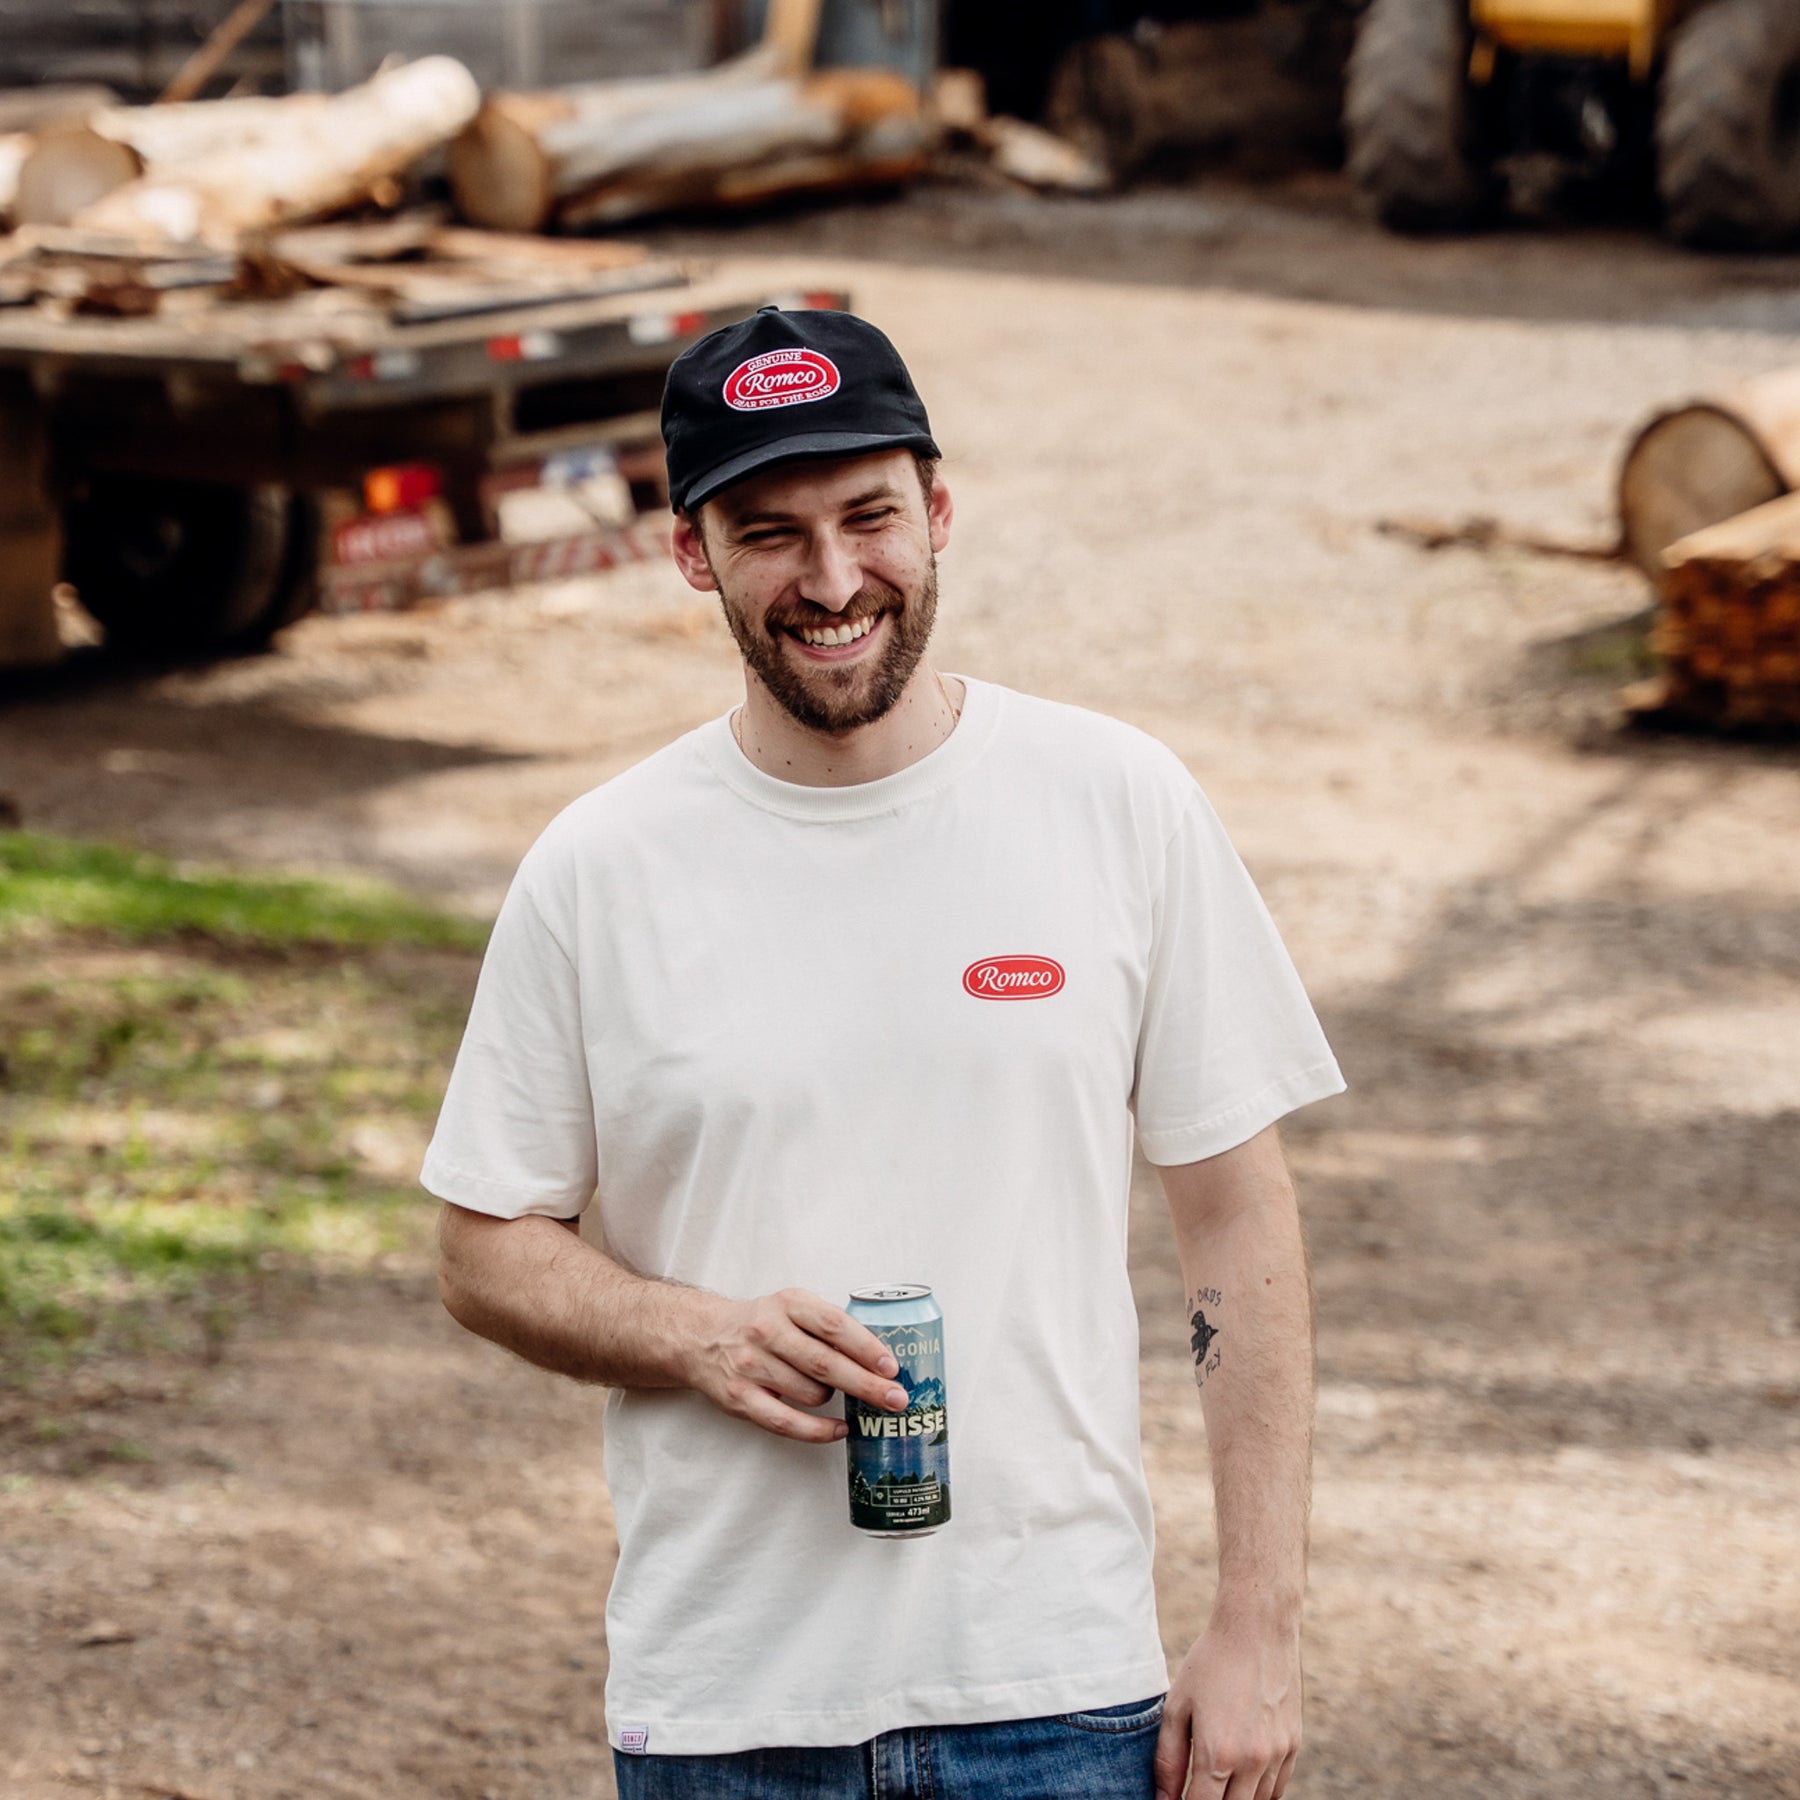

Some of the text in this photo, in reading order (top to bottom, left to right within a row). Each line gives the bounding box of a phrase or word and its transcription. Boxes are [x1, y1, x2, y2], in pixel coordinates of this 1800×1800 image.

[747, 352, 802, 371] GENUINE
[745, 370, 817, 395] Romco
[733, 384, 832, 408] GEAR FOR THE ROAD
[977, 966, 1052, 992] Romco
[858, 1410, 945, 1438] WEISSE
[907, 1506, 930, 1517] 473ml
